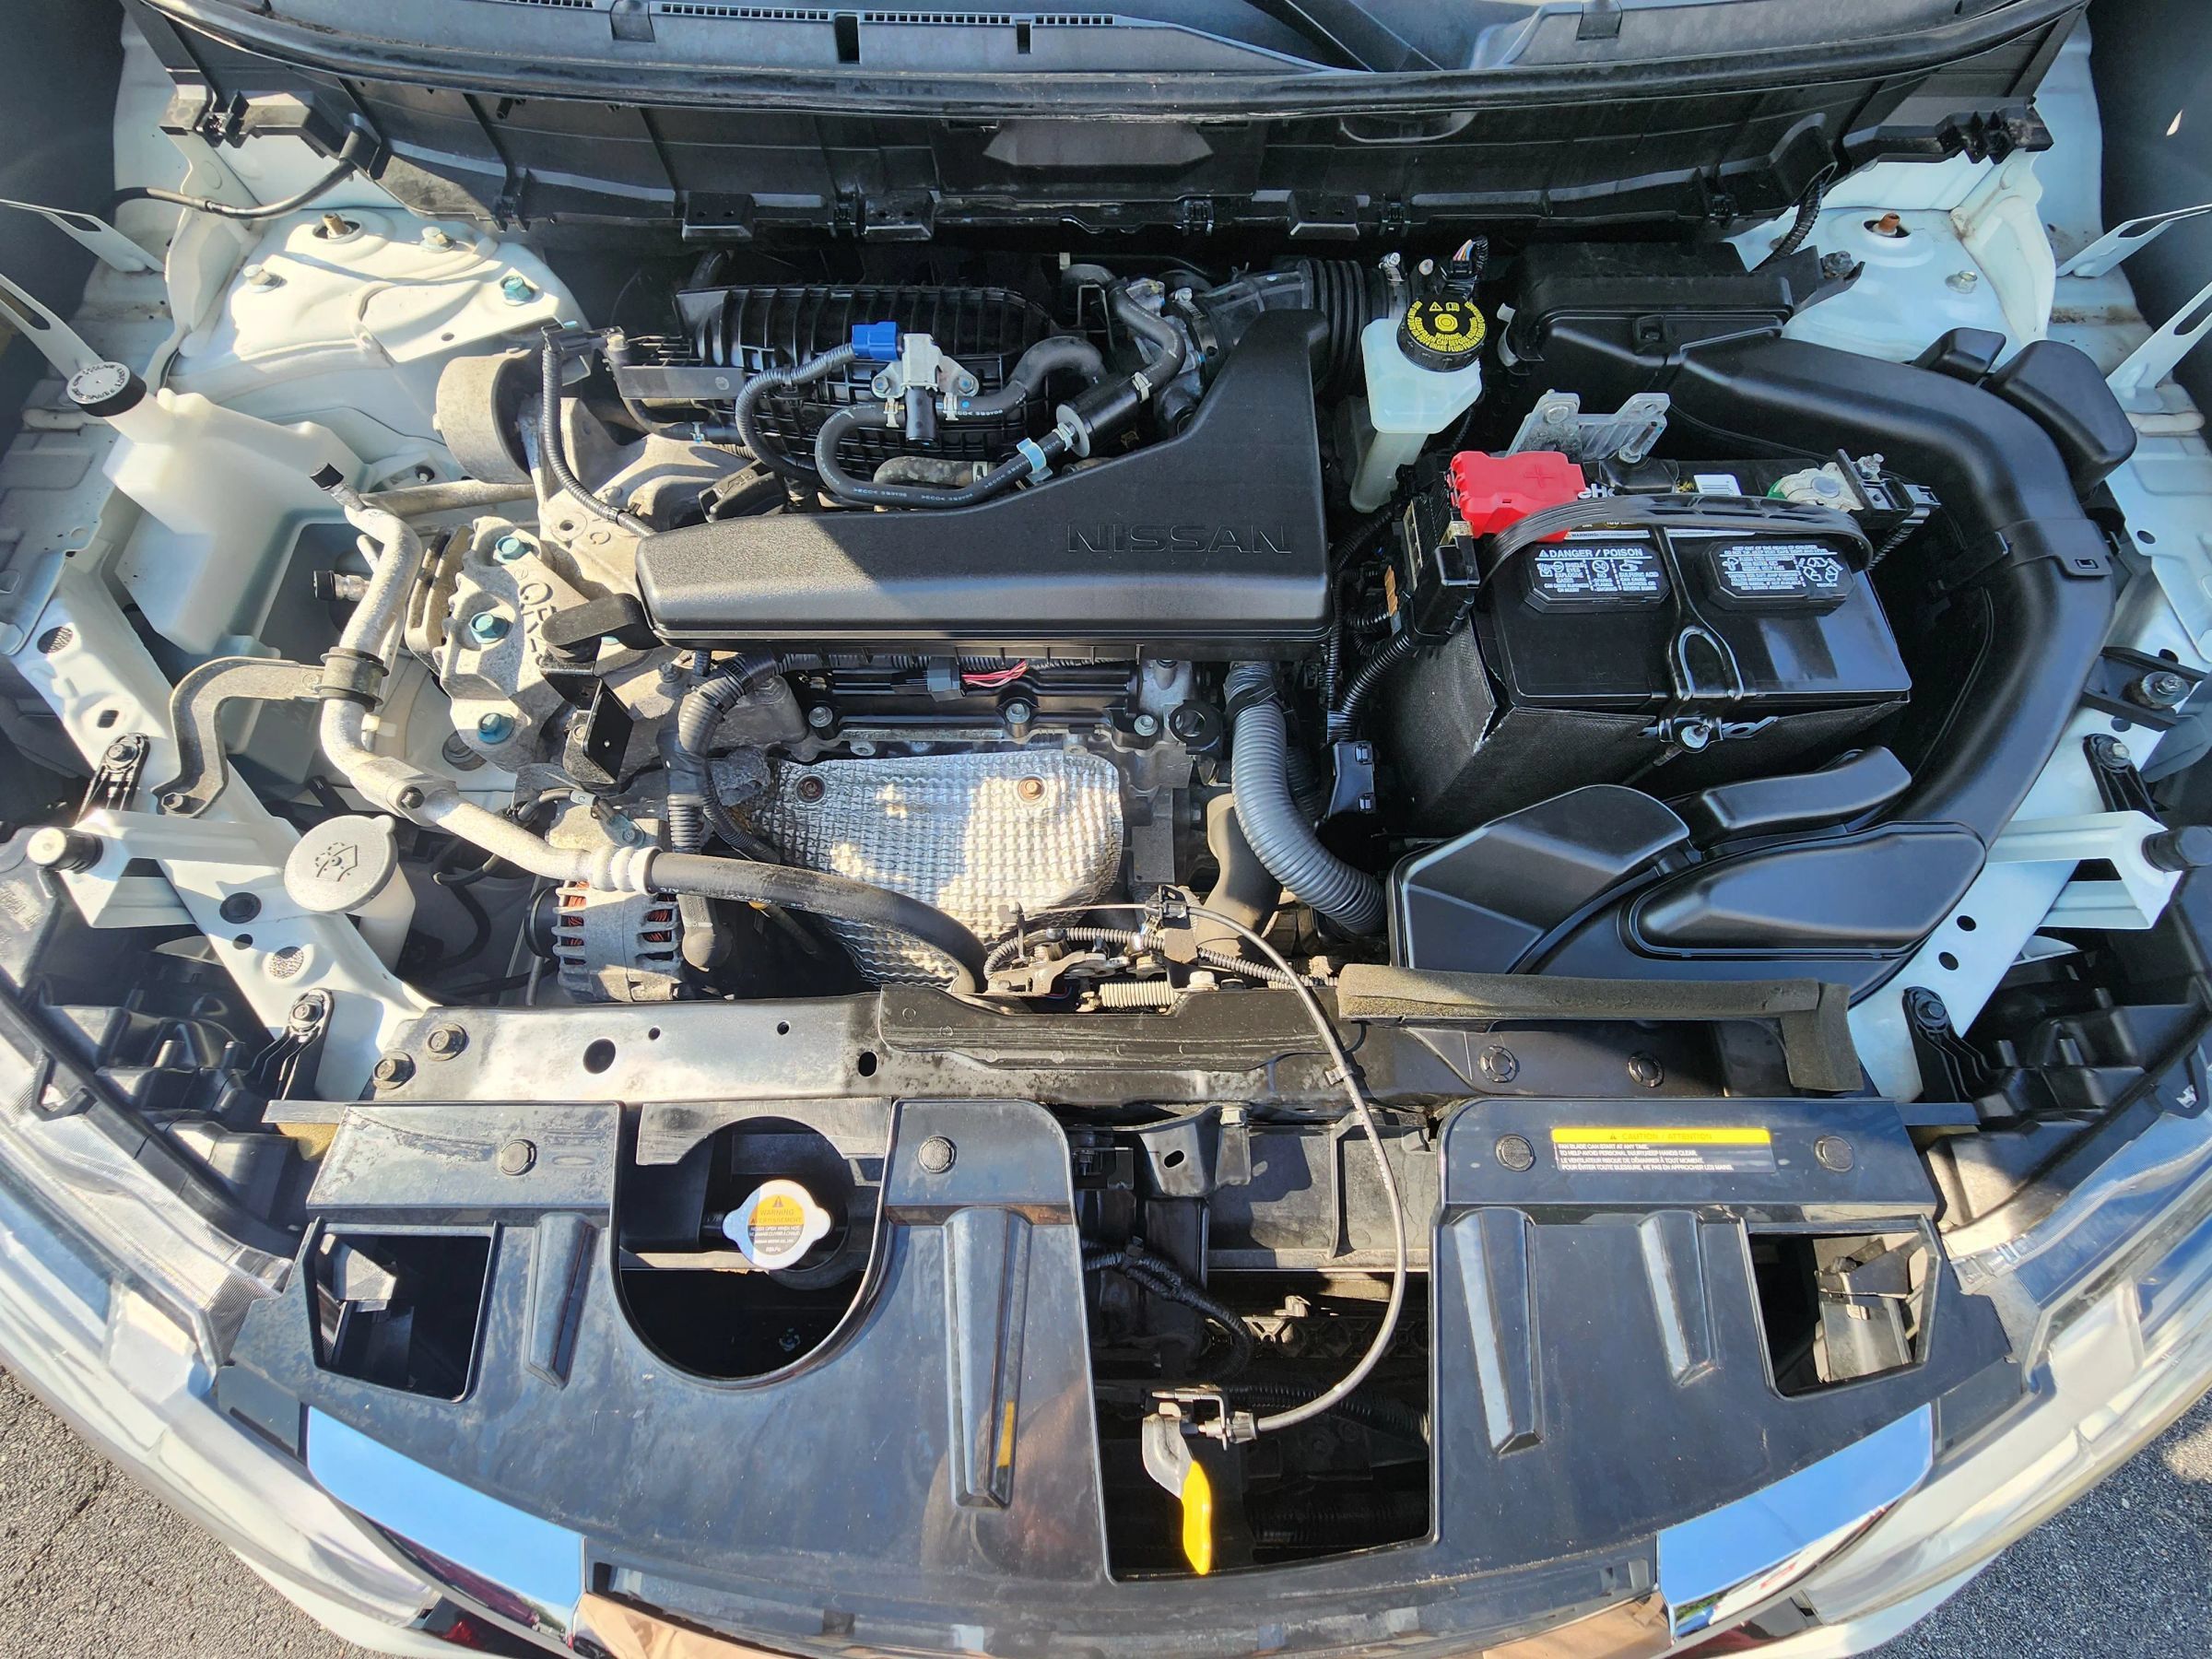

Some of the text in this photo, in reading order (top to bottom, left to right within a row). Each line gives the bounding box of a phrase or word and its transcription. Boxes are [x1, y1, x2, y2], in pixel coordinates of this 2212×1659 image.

[1067, 524, 1292, 553] NISSAN
[1549, 550, 1593, 559] DANGER
[1603, 548, 1643, 557] POISON
